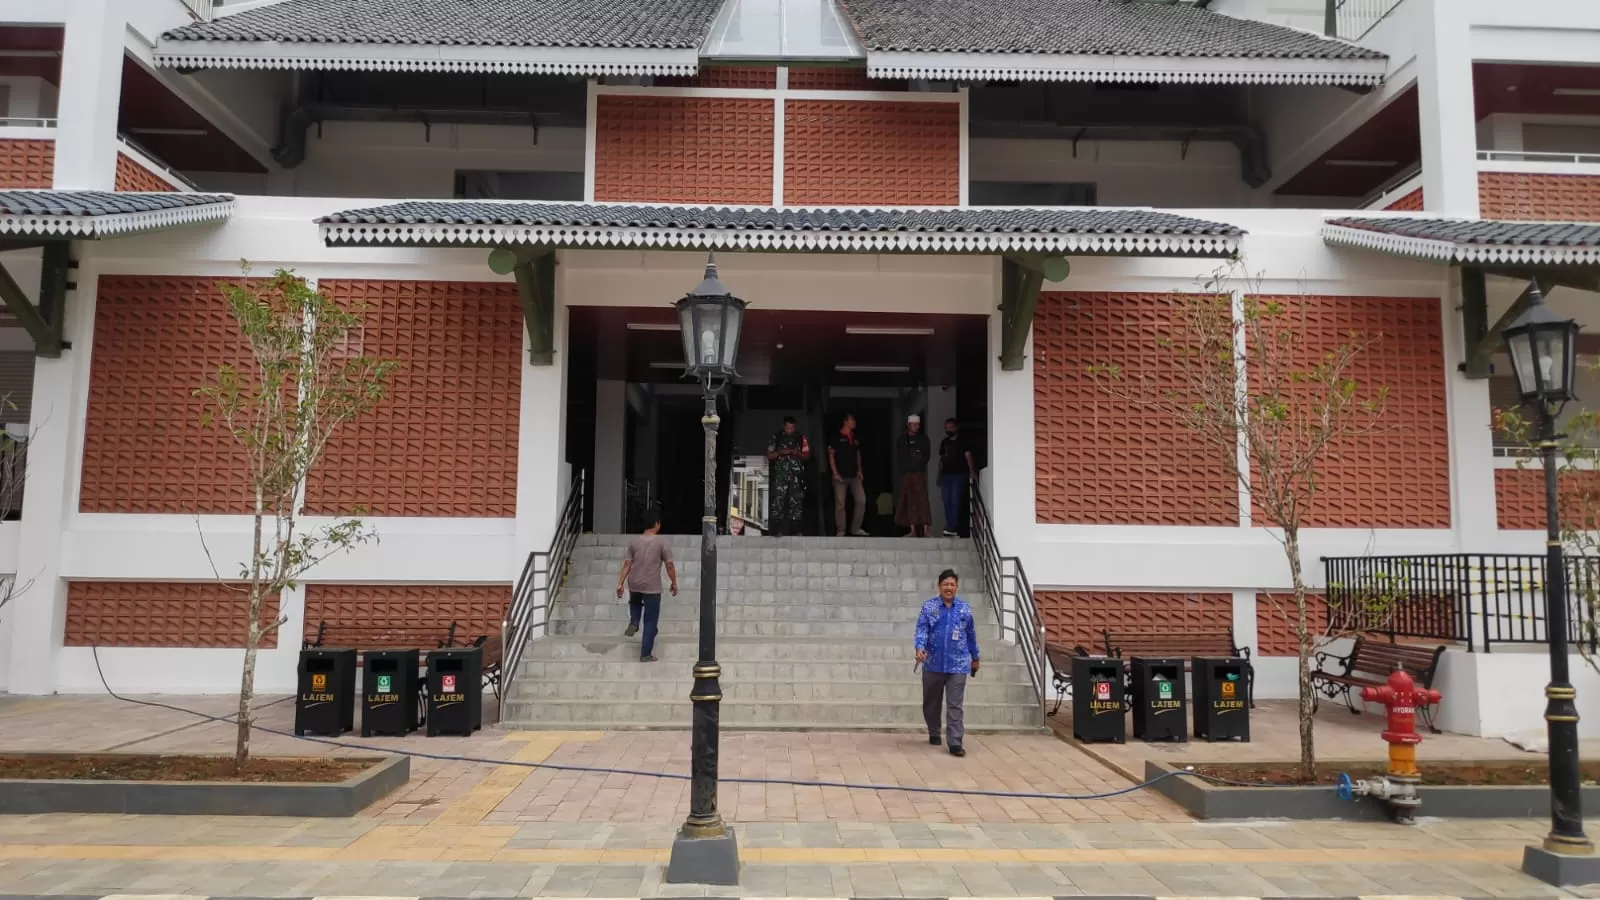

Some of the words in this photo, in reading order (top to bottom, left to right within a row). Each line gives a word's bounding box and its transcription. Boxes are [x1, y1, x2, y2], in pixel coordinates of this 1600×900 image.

[302, 694, 335, 702] LASEM
[368, 694, 399, 702] LASEM
[433, 694, 465, 702] LASEM
[1151, 700, 1181, 708] LASEM
[1214, 700, 1244, 708] LASEM
